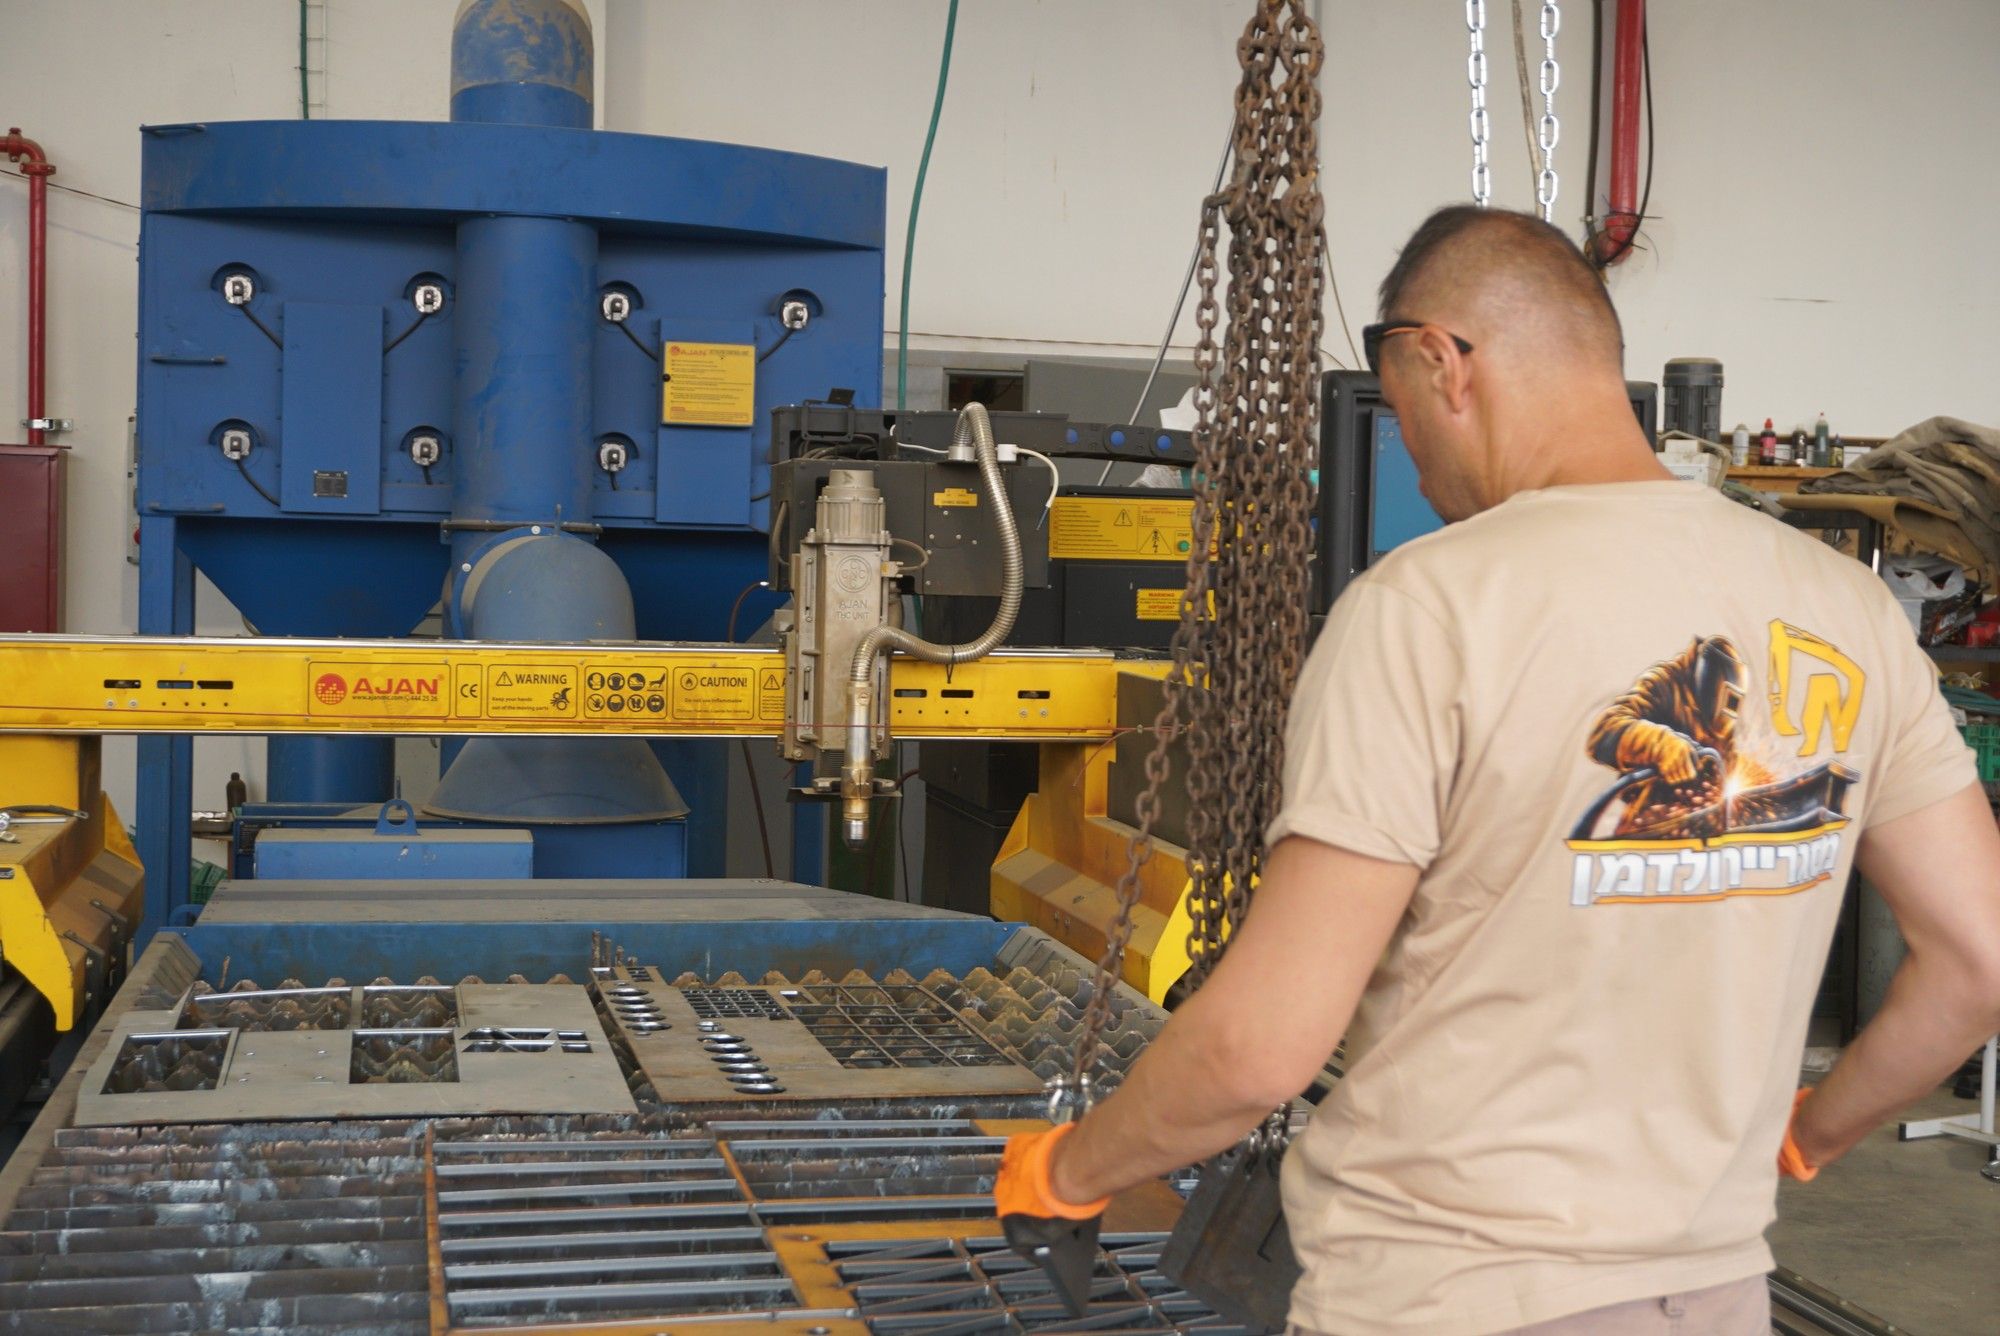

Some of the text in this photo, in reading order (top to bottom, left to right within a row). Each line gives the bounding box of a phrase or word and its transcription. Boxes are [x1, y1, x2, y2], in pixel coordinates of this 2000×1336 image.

[839, 600, 868, 610] AJAN
[853, 611, 870, 620] UNIT
[515, 674, 567, 685] WARNING
[700, 677, 747, 687] CAUTION!
[352, 678, 438, 695] AJAN
